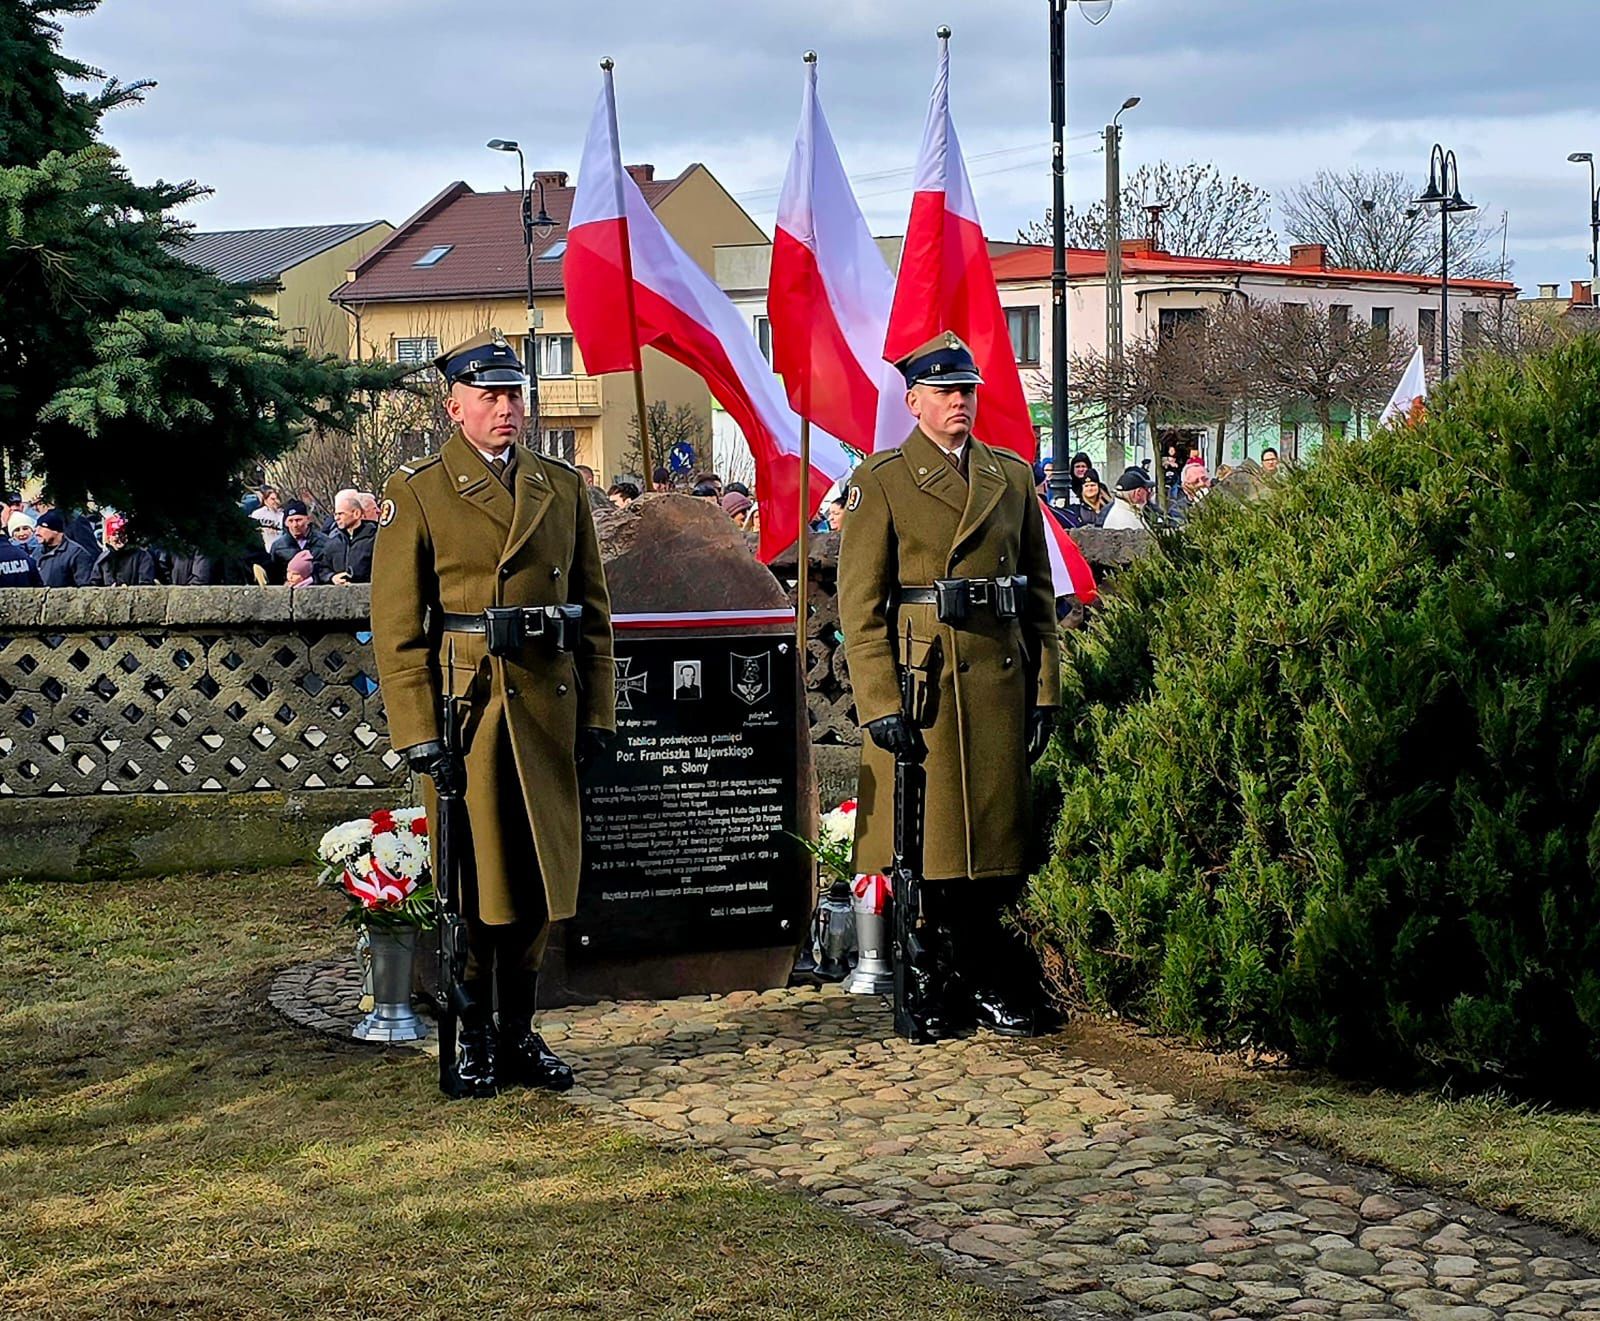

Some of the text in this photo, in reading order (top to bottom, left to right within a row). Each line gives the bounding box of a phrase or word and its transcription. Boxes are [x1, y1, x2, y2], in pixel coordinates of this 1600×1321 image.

[627, 736, 657, 747] Tablica
[616, 744, 754, 762] Por. Franciszka Majewskiego
[662, 764, 677, 777] ps.
